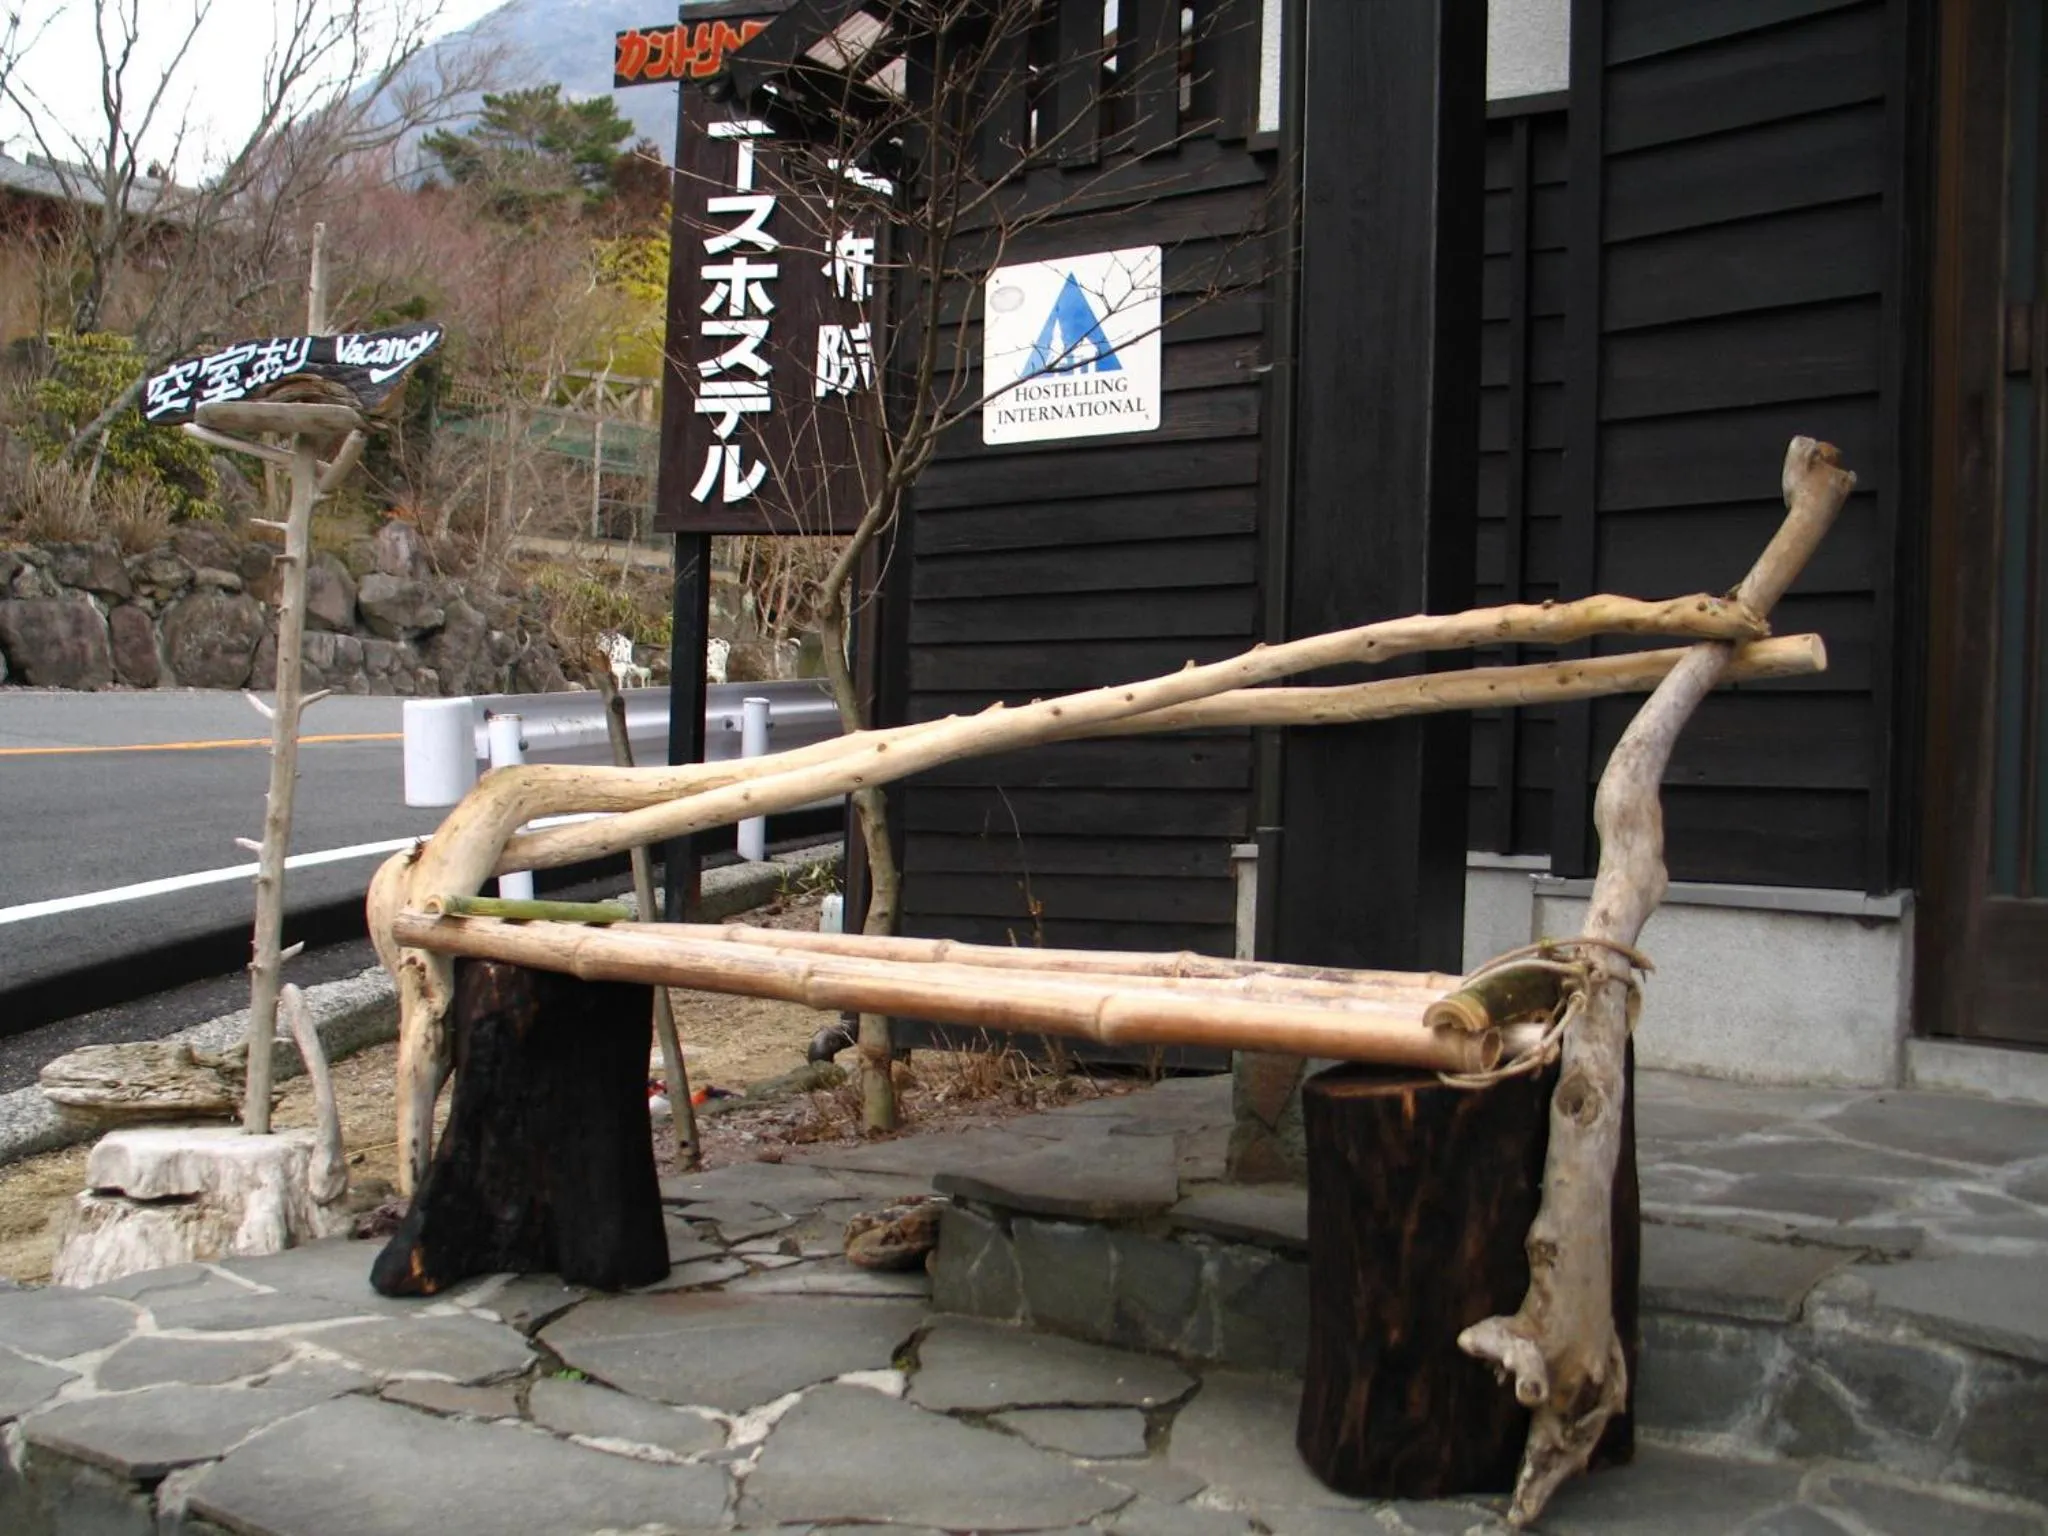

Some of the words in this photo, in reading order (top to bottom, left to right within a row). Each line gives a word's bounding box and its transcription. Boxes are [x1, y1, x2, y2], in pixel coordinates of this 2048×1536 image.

[145, 336, 312, 420] 空室あり
[335, 330, 440, 384] Vacancy
[1014, 376, 1129, 403] HOSTELLING
[997, 396, 1146, 425] INTERNATIONAL
